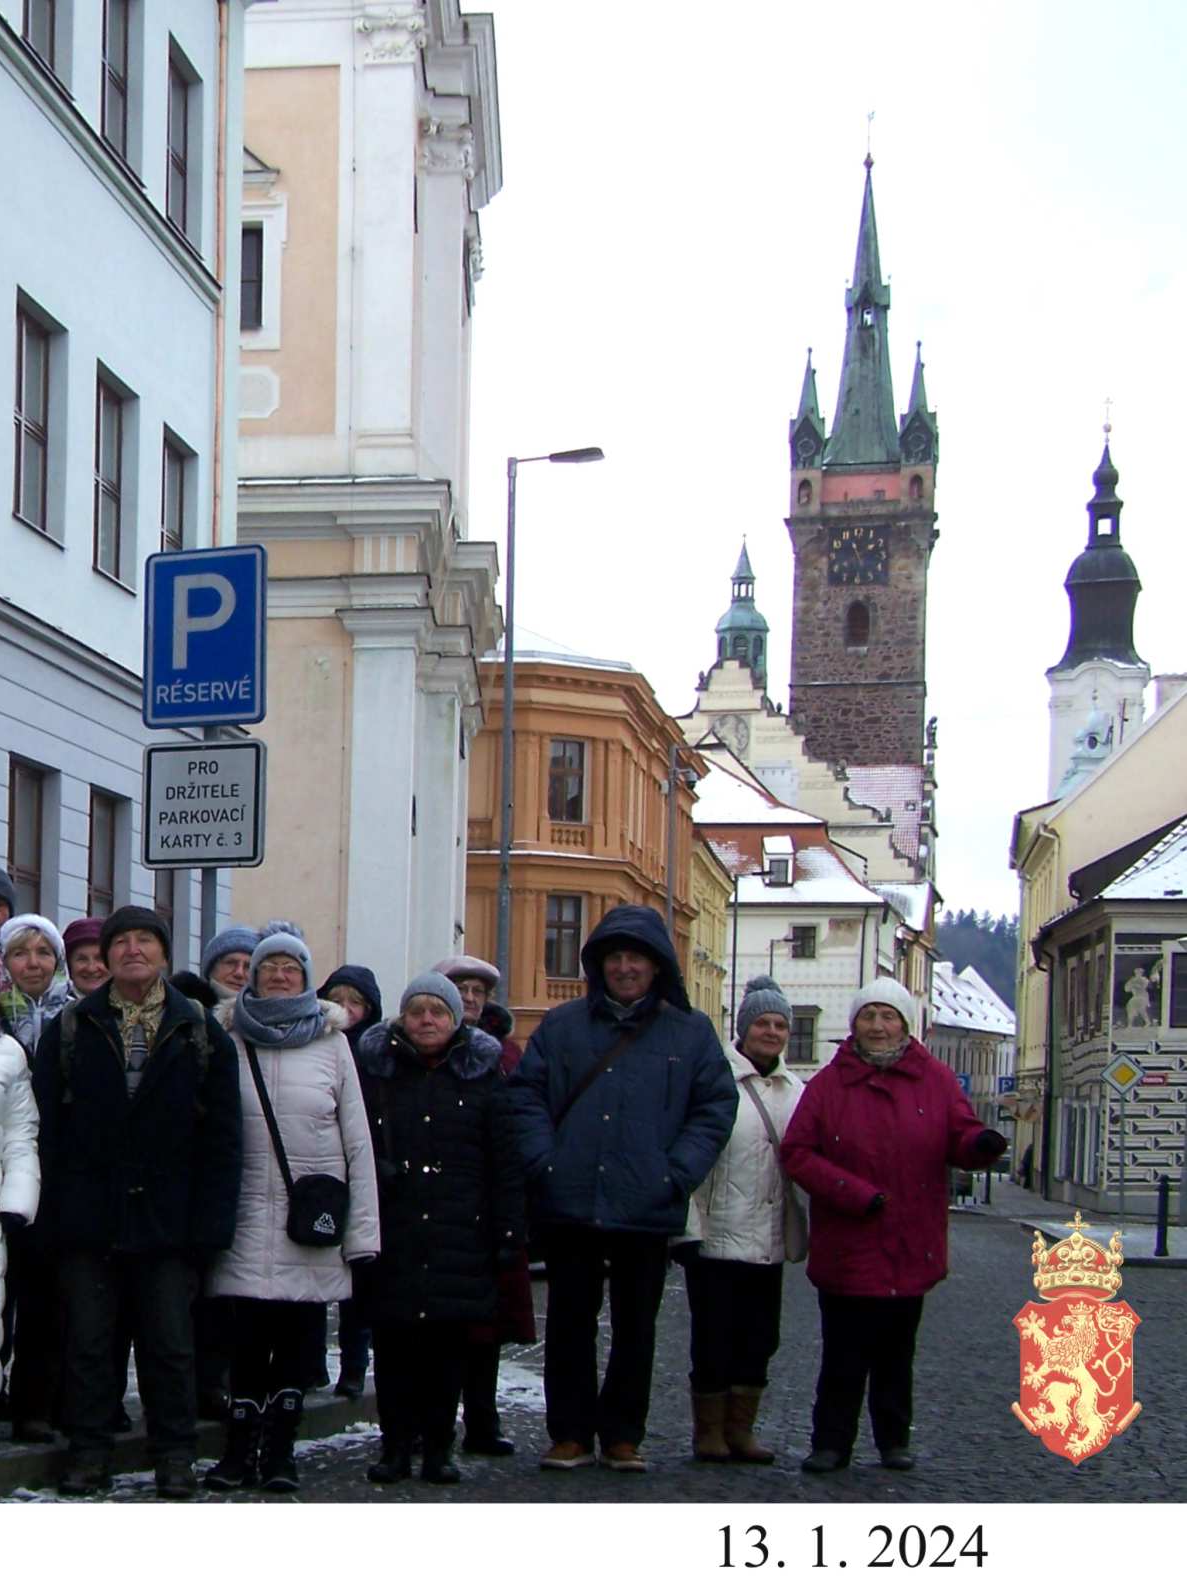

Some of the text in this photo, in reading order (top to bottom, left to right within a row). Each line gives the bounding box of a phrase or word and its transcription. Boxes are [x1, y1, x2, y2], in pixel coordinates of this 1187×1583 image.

[172, 573, 236, 669] P
[155, 674, 252, 704] RÉSERVÉ
[187, 760, 219, 775] PRO
[165, 782, 240, 800] DRŽITELE
[159, 804, 246, 825] PARKOVACÍ
[160, 832, 243, 848] KARTY č. 3
